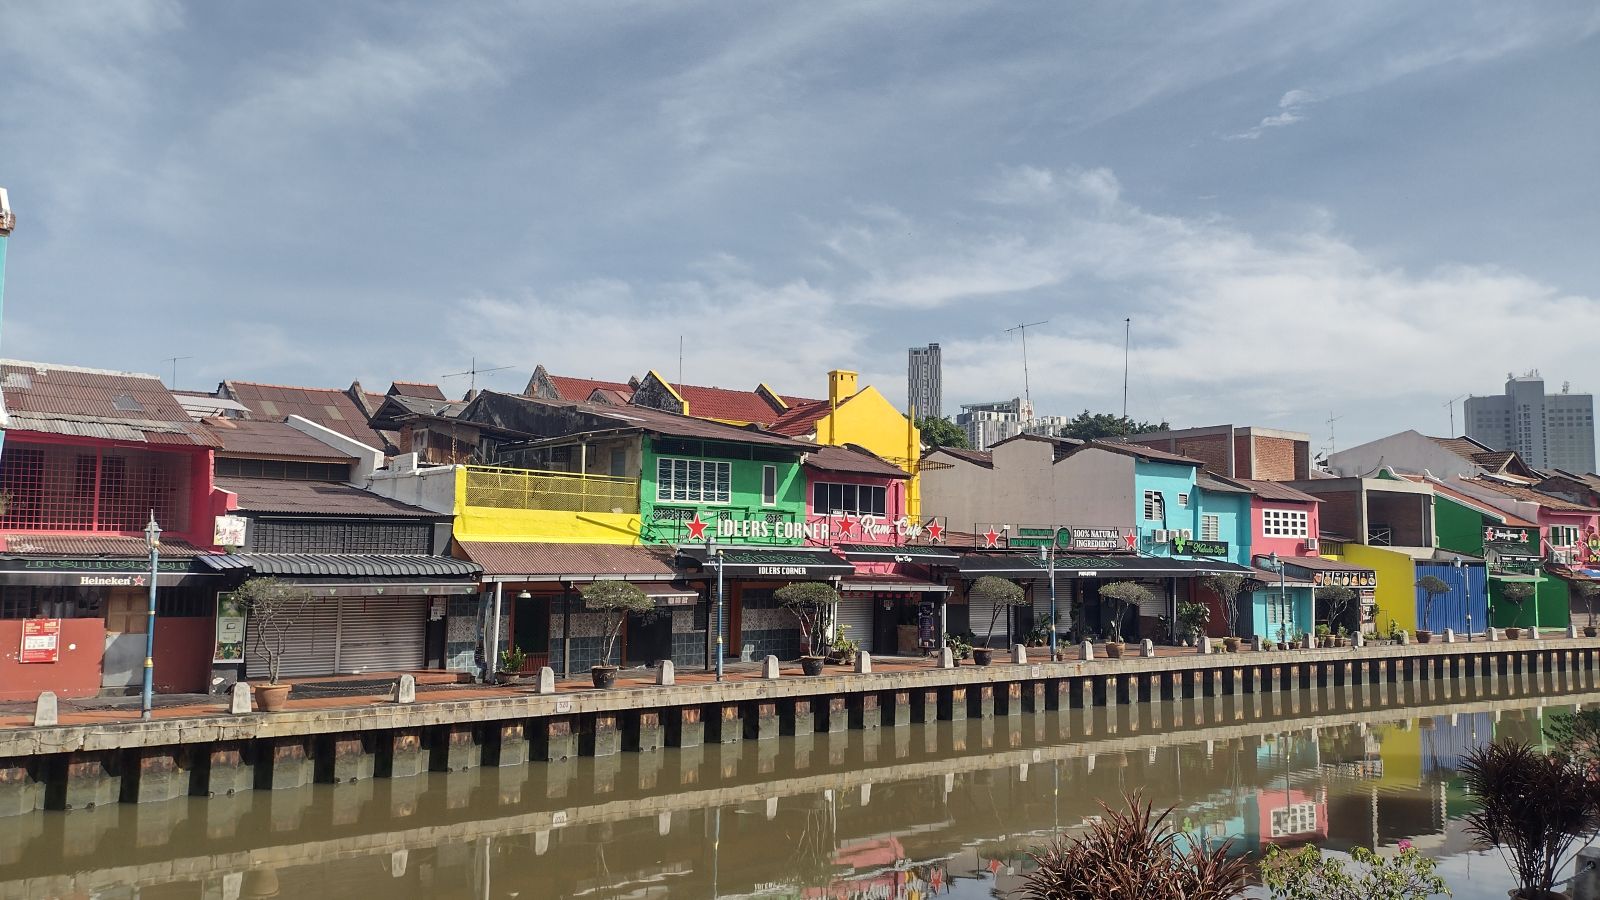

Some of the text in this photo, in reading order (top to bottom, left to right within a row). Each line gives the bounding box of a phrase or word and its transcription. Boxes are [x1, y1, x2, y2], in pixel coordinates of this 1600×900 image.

[717, 518, 829, 540] IDLERS CORNER
[861, 514, 890, 540] Ram
[1073, 529, 1119, 539] 100% NATURAL
[1076, 539, 1117, 548] INGREDIENTS
[759, 567, 807, 575] IDLERS CORNER
[80, 576, 131, 585] Heineken
